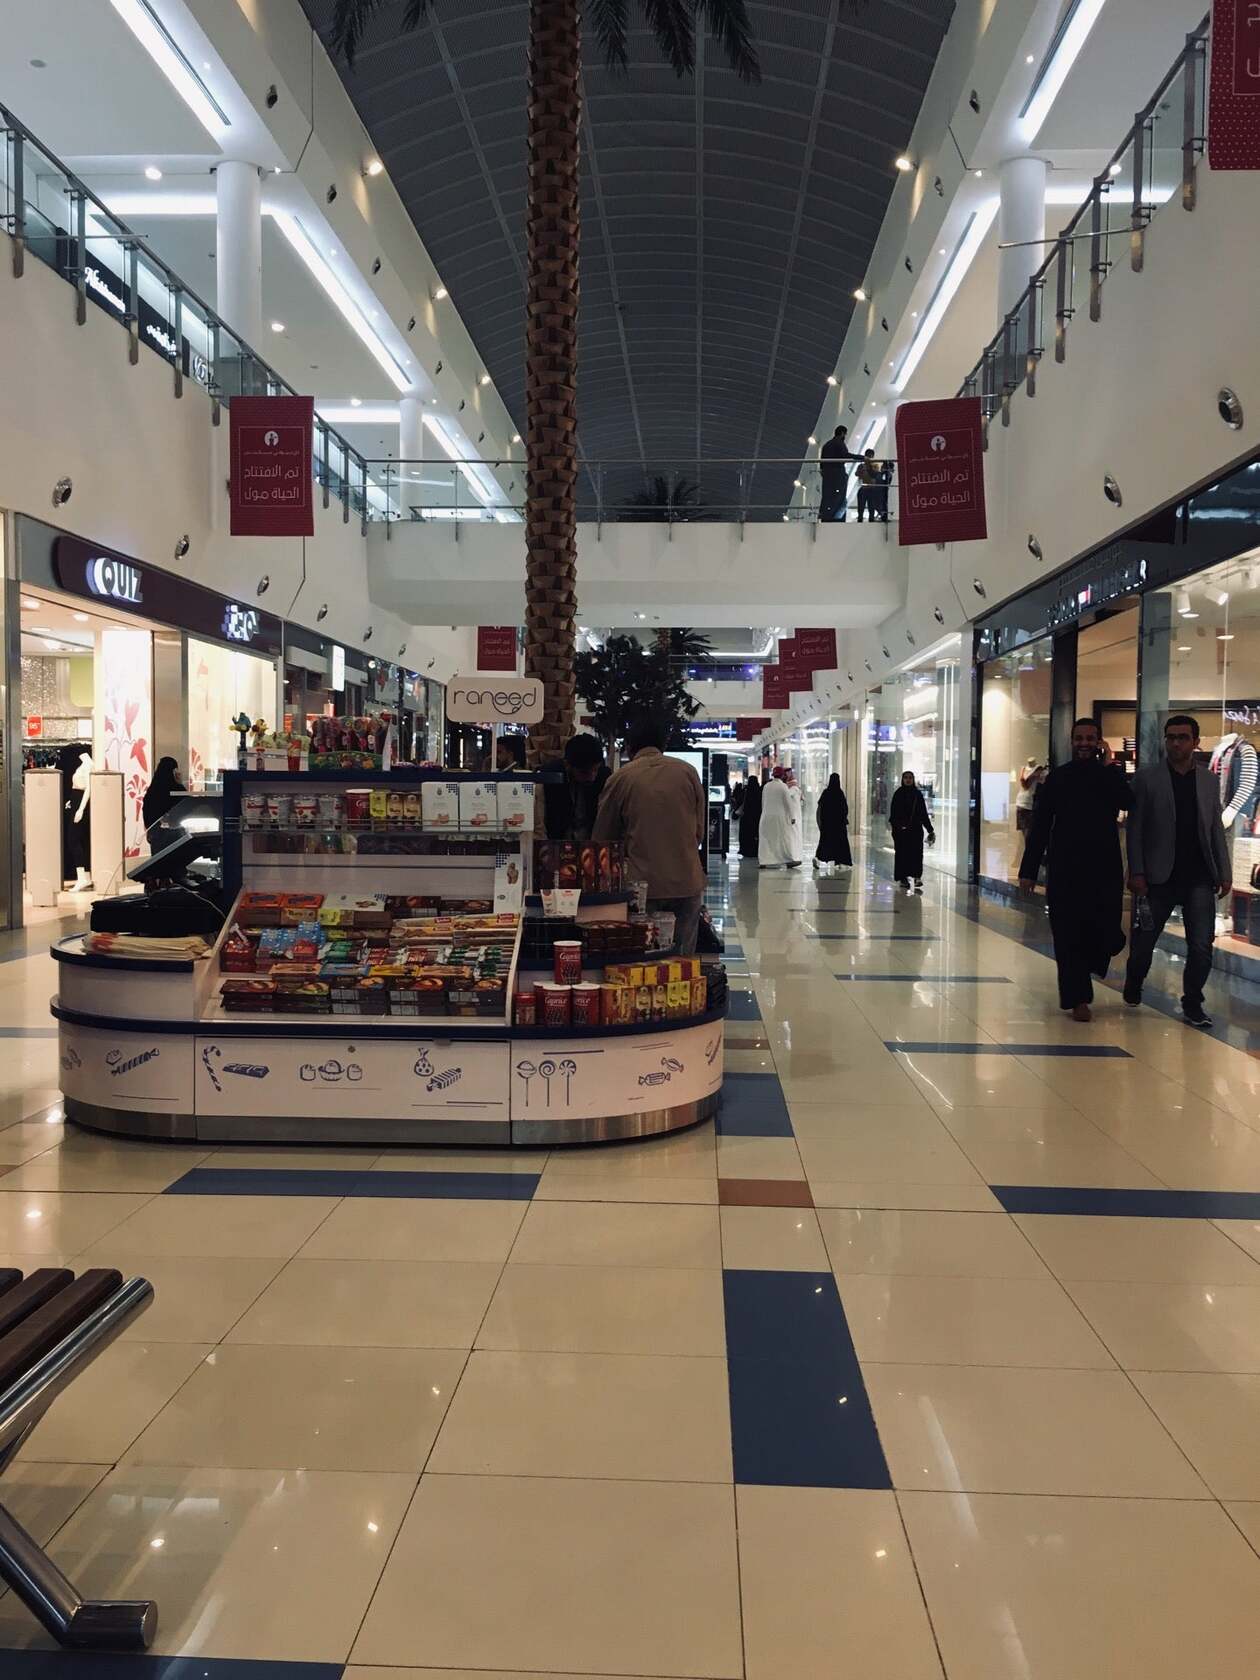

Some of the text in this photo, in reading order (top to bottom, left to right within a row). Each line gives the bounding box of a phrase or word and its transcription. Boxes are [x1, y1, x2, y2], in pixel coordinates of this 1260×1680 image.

[284, 465, 299, 480] تم
[953, 469, 969, 484] تم
[244, 486, 299, 501] الحياة مول
[911, 494, 938, 508] مول
[86, 557, 143, 603] QUIZ
[453, 686, 537, 714] raneed
